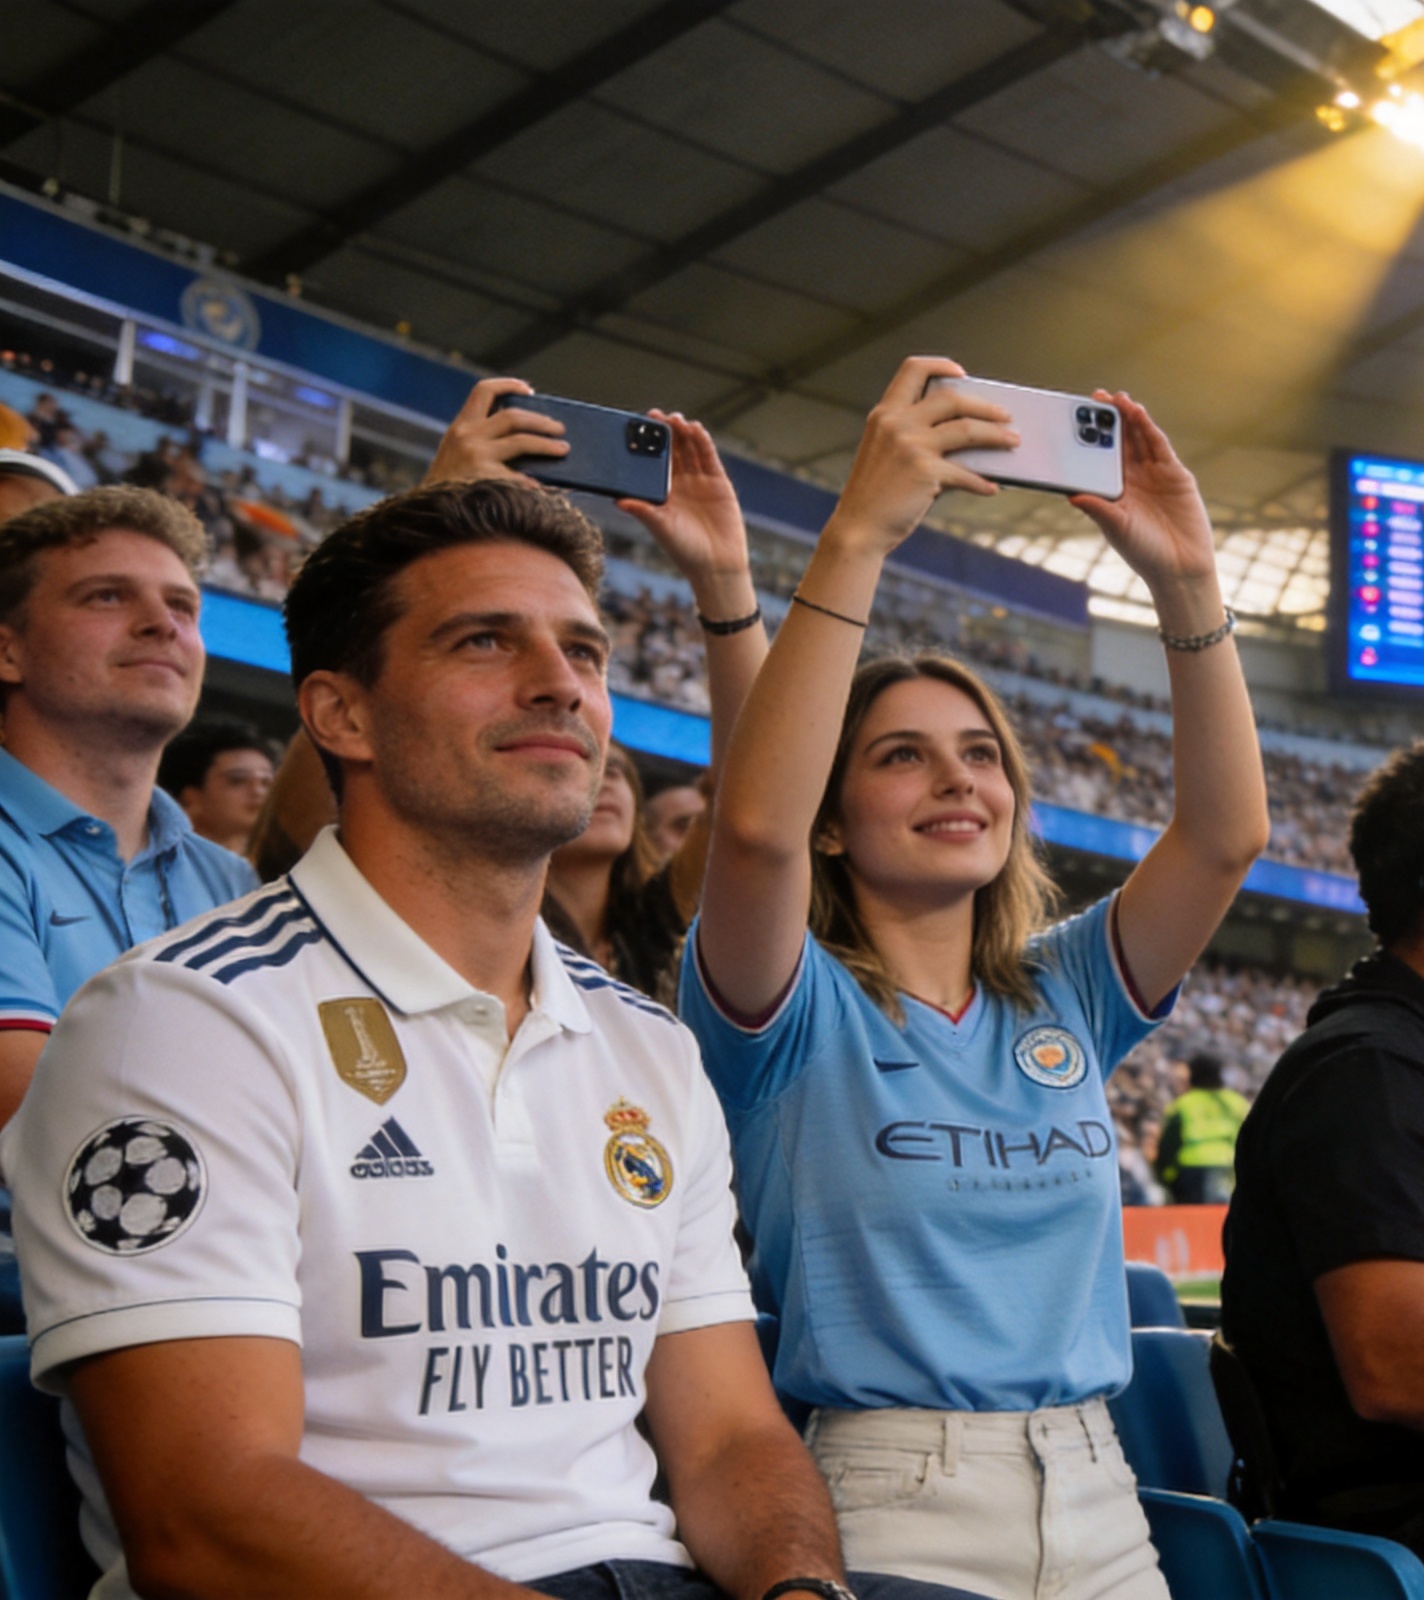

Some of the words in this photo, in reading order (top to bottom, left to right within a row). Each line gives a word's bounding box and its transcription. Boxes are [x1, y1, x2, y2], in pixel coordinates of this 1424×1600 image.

[875, 1120, 1111, 1168] ETIHAD
[353, 1243, 660, 1339] Emirates
[418, 1344, 492, 1416] FLY
[509, 1336, 637, 1407] BETTER
